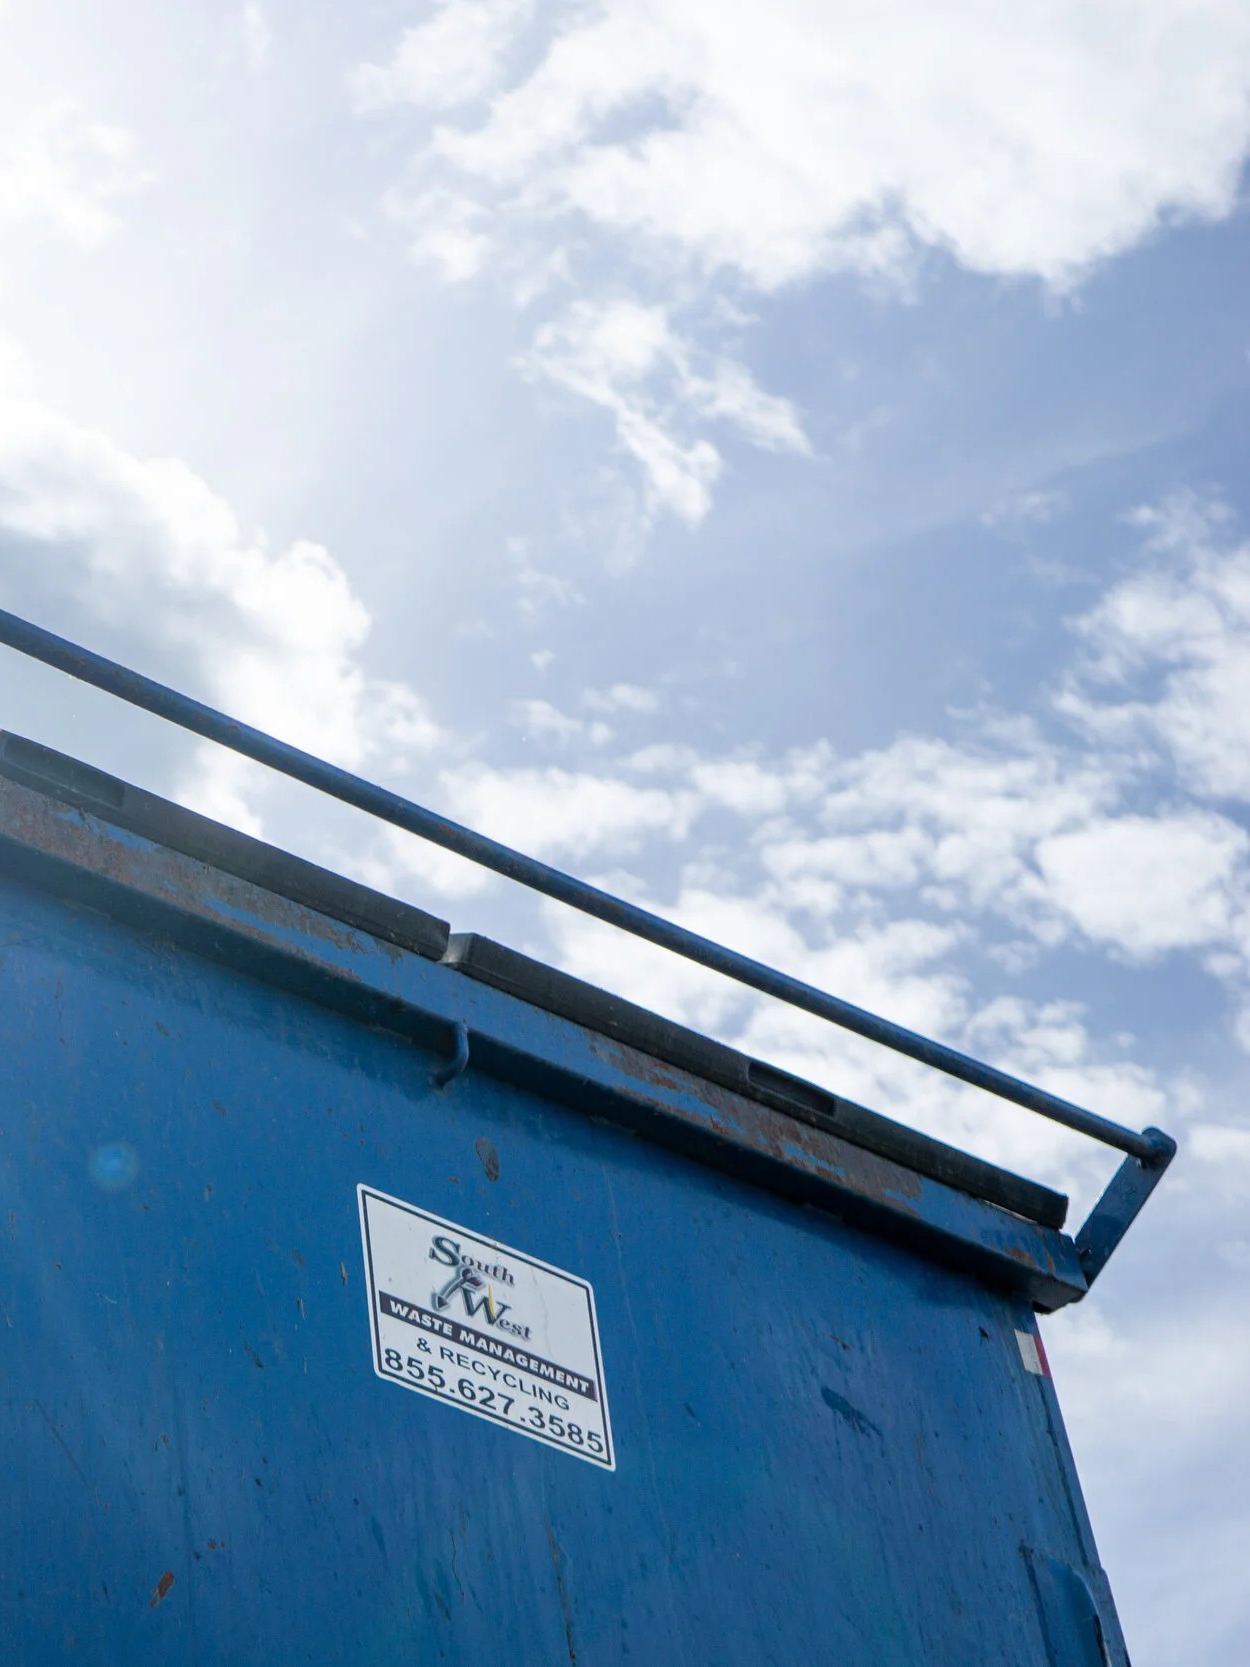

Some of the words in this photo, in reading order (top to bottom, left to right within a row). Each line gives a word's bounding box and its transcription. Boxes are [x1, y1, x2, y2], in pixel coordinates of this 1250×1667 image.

[428, 1234, 516, 1287] South
[389, 1300, 454, 1337] WASTE
[459, 1330, 590, 1394] MANAGEMENT
[457, 1284, 532, 1341] West
[384, 1347, 605, 1454] 855.627.3585
[416, 1337, 433, 1355] &
[440, 1346, 571, 1411] RECYCLING
